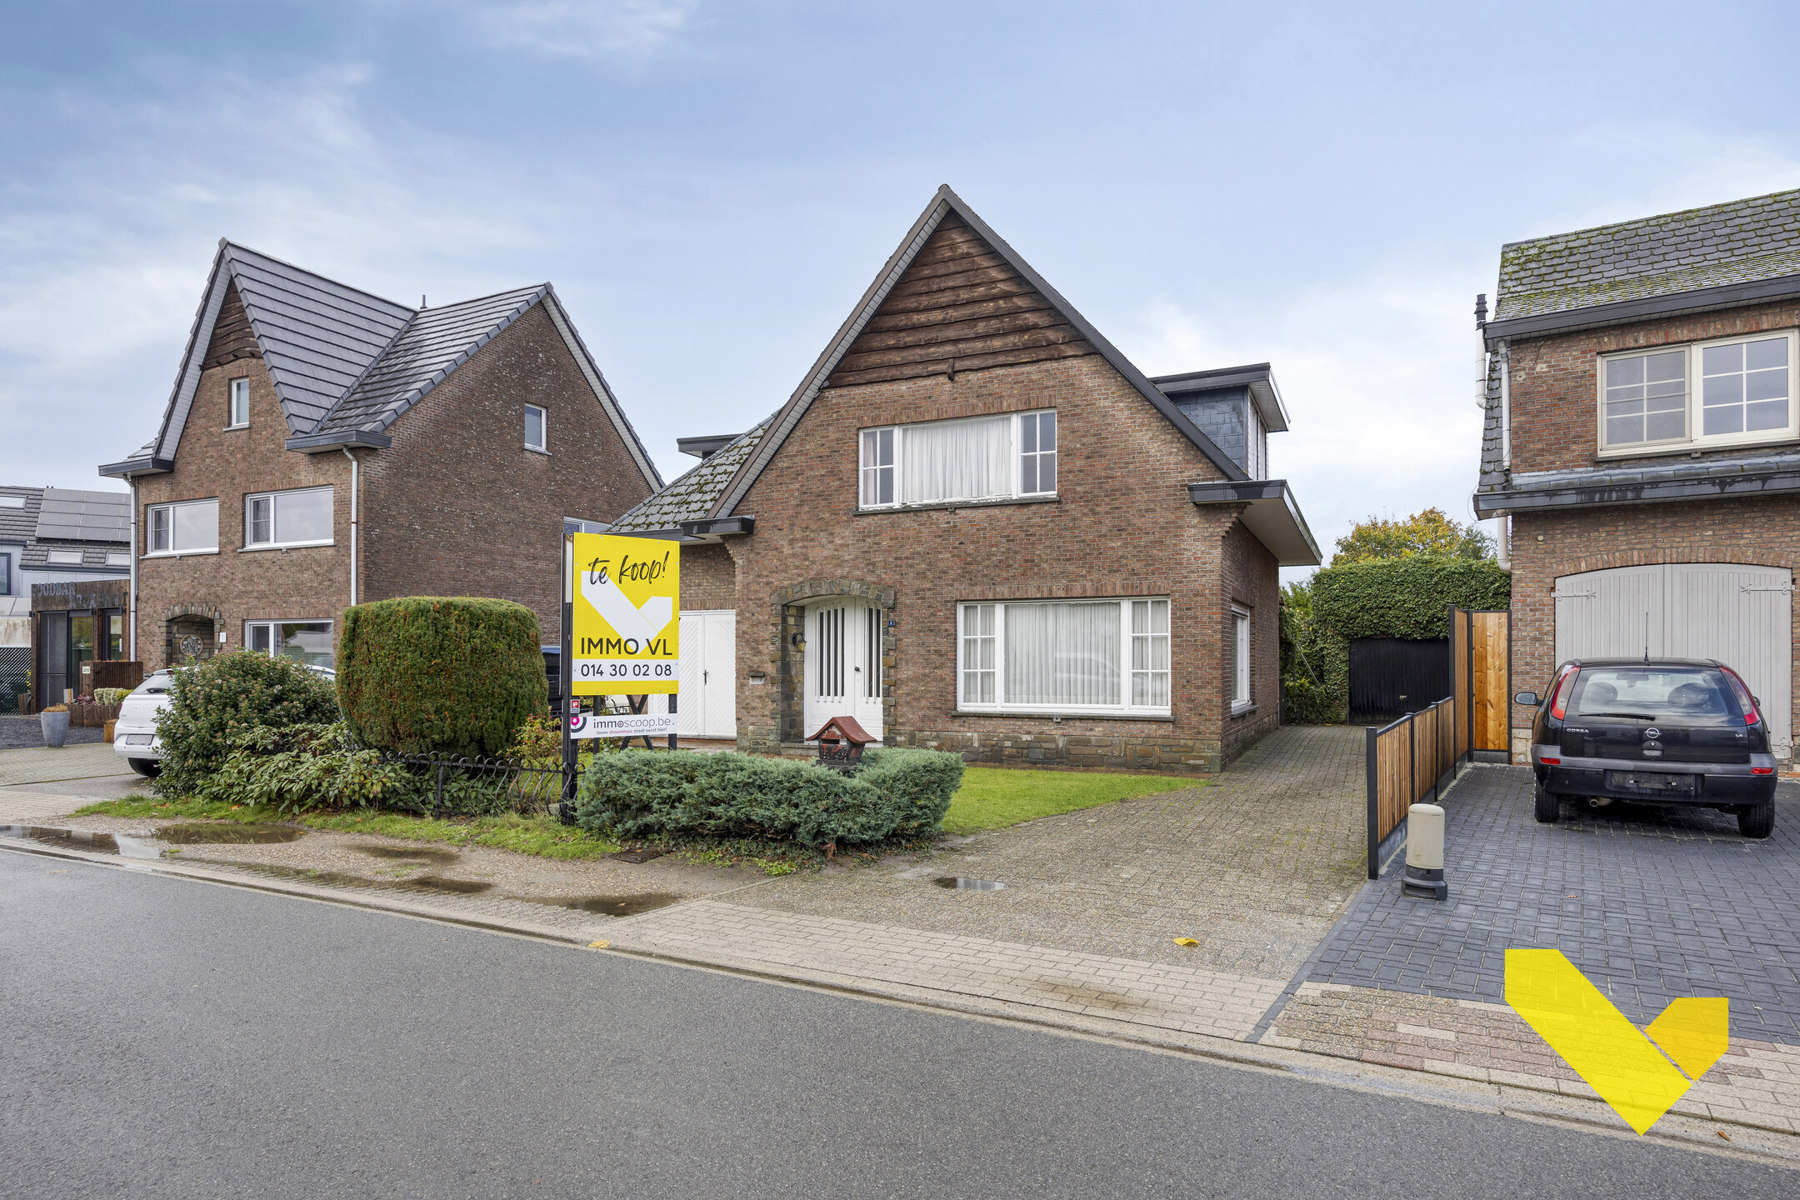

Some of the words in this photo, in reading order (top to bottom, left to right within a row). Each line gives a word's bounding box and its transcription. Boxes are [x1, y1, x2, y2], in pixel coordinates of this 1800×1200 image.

[588, 557, 610, 585] te
[618, 551, 670, 585] koop!
[581, 637, 640, 655] IMMO
[646, 638, 673, 656] VL
[581, 664, 604, 677] 014
[609, 664, 628, 677] 30
[632, 664, 650, 677] 02
[655, 664, 673, 677] 08
